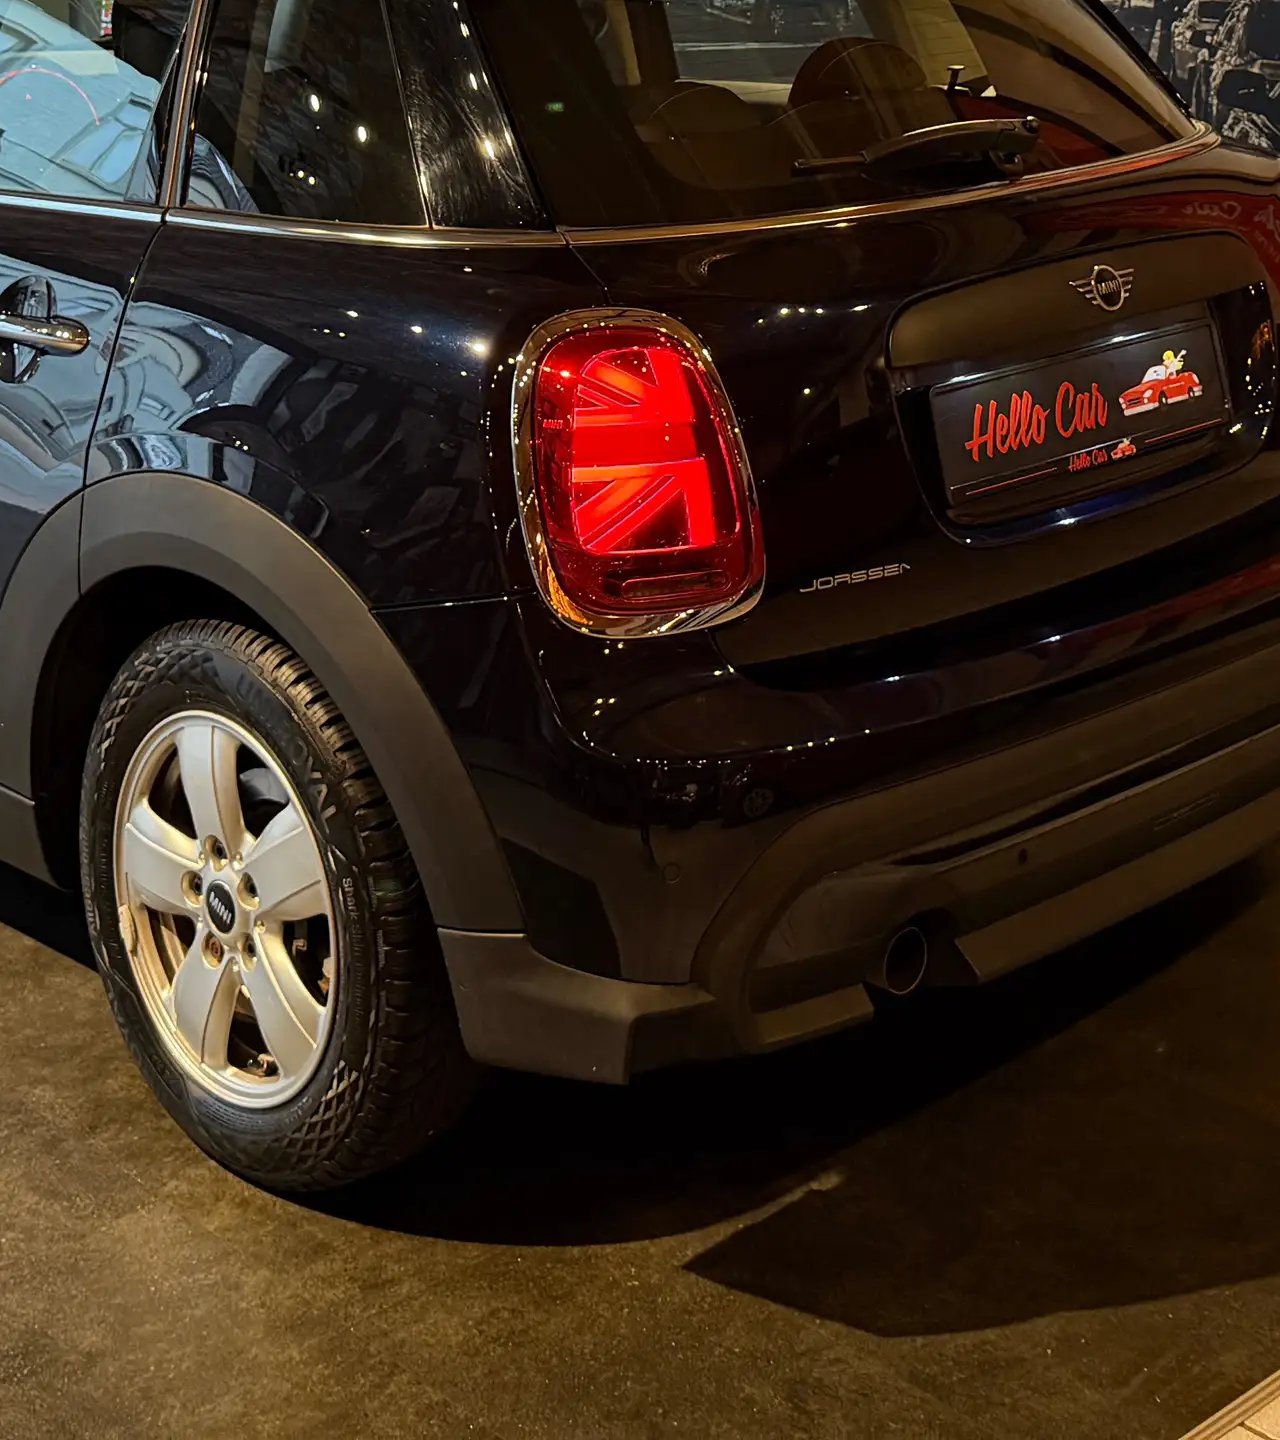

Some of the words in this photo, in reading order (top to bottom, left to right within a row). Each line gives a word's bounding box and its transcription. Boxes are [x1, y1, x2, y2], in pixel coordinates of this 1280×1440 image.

[1096, 279, 1120, 295] MINI
[965, 390, 1050, 462] Hello
[1055, 381, 1109, 437] Car
[1068, 451, 1092, 472] Hello
[1092, 448, 1108, 467] Car
[208, 891, 234, 927] MINI
